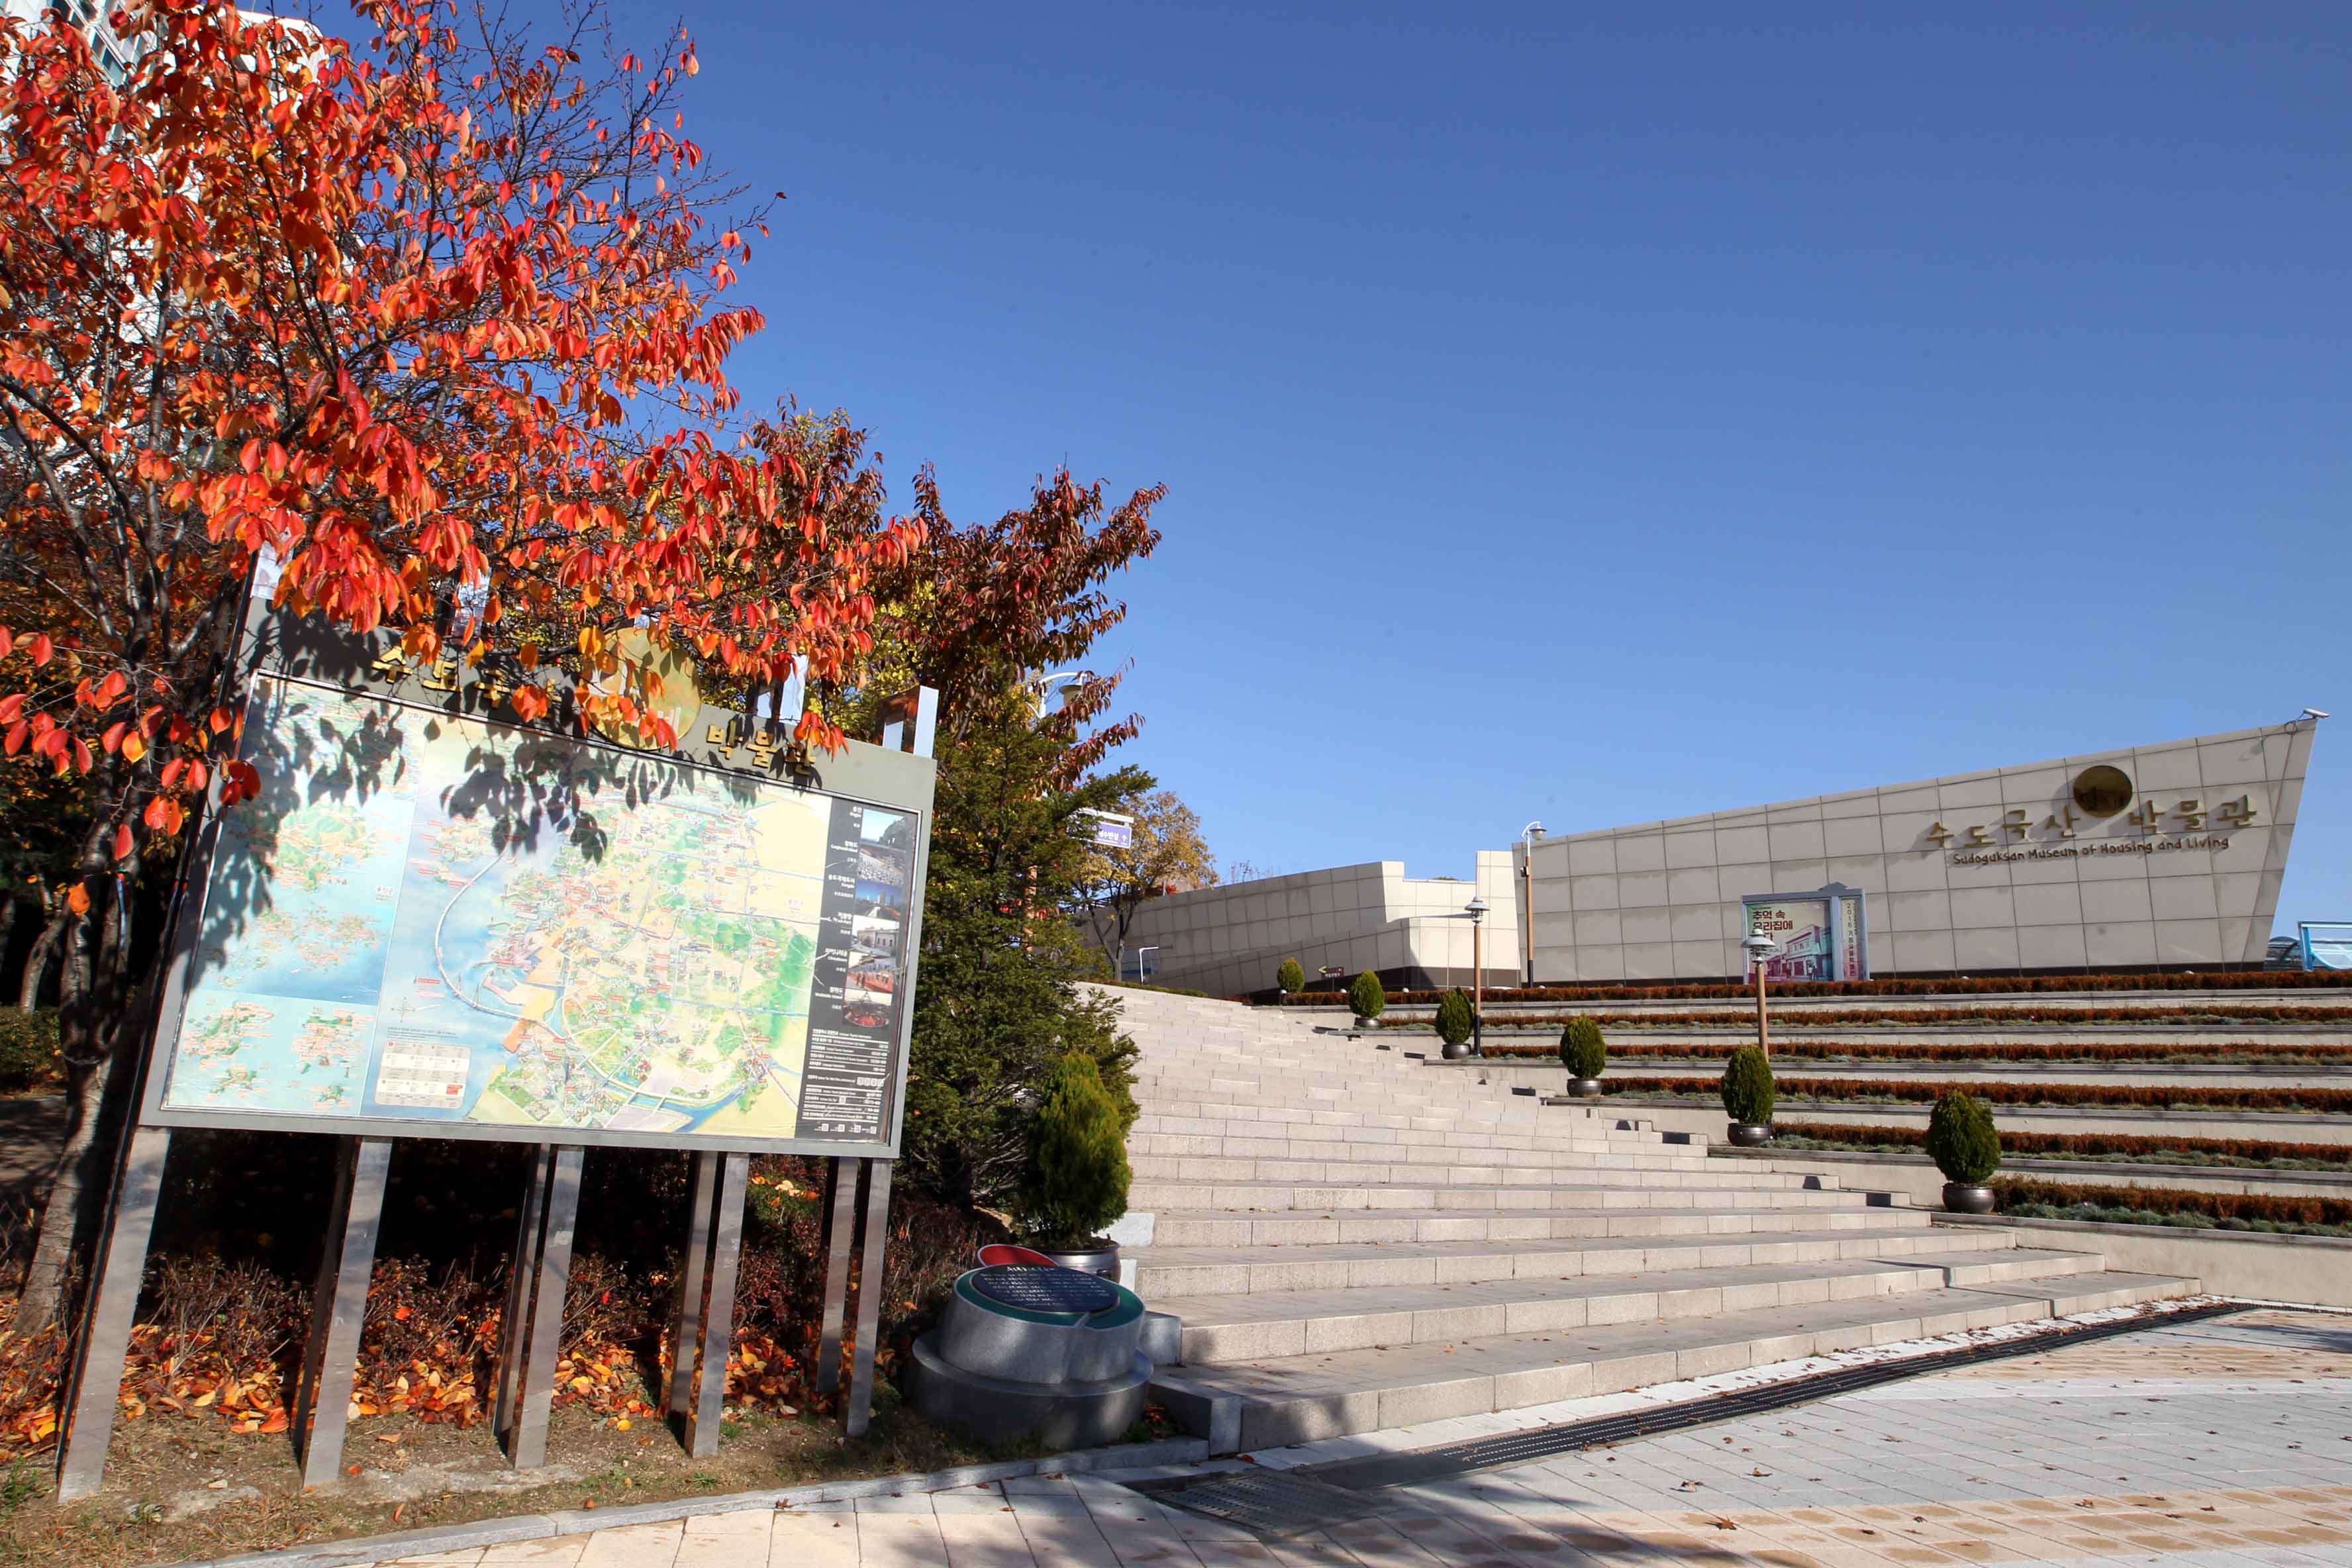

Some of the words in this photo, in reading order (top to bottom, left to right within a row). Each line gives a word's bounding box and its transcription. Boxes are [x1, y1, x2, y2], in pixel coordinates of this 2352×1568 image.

[707, 719, 816, 775] 박물관
[1926, 805, 2081, 848] 수도국산
[2128, 794, 2257, 834] 박물관
[1953, 850, 2025, 865] Sudoguksan
[2028, 848, 2078, 859] Museum
[2081, 844, 2096, 856] of
[2100, 842, 2153, 854] Housing
[2157, 837, 2182, 850] and
[2186, 836, 2230, 849] Living
[1753, 910, 1772, 920] 추억
[1775, 909, 1785, 919] 속
[1753, 920, 1793, 931] 우리집에
